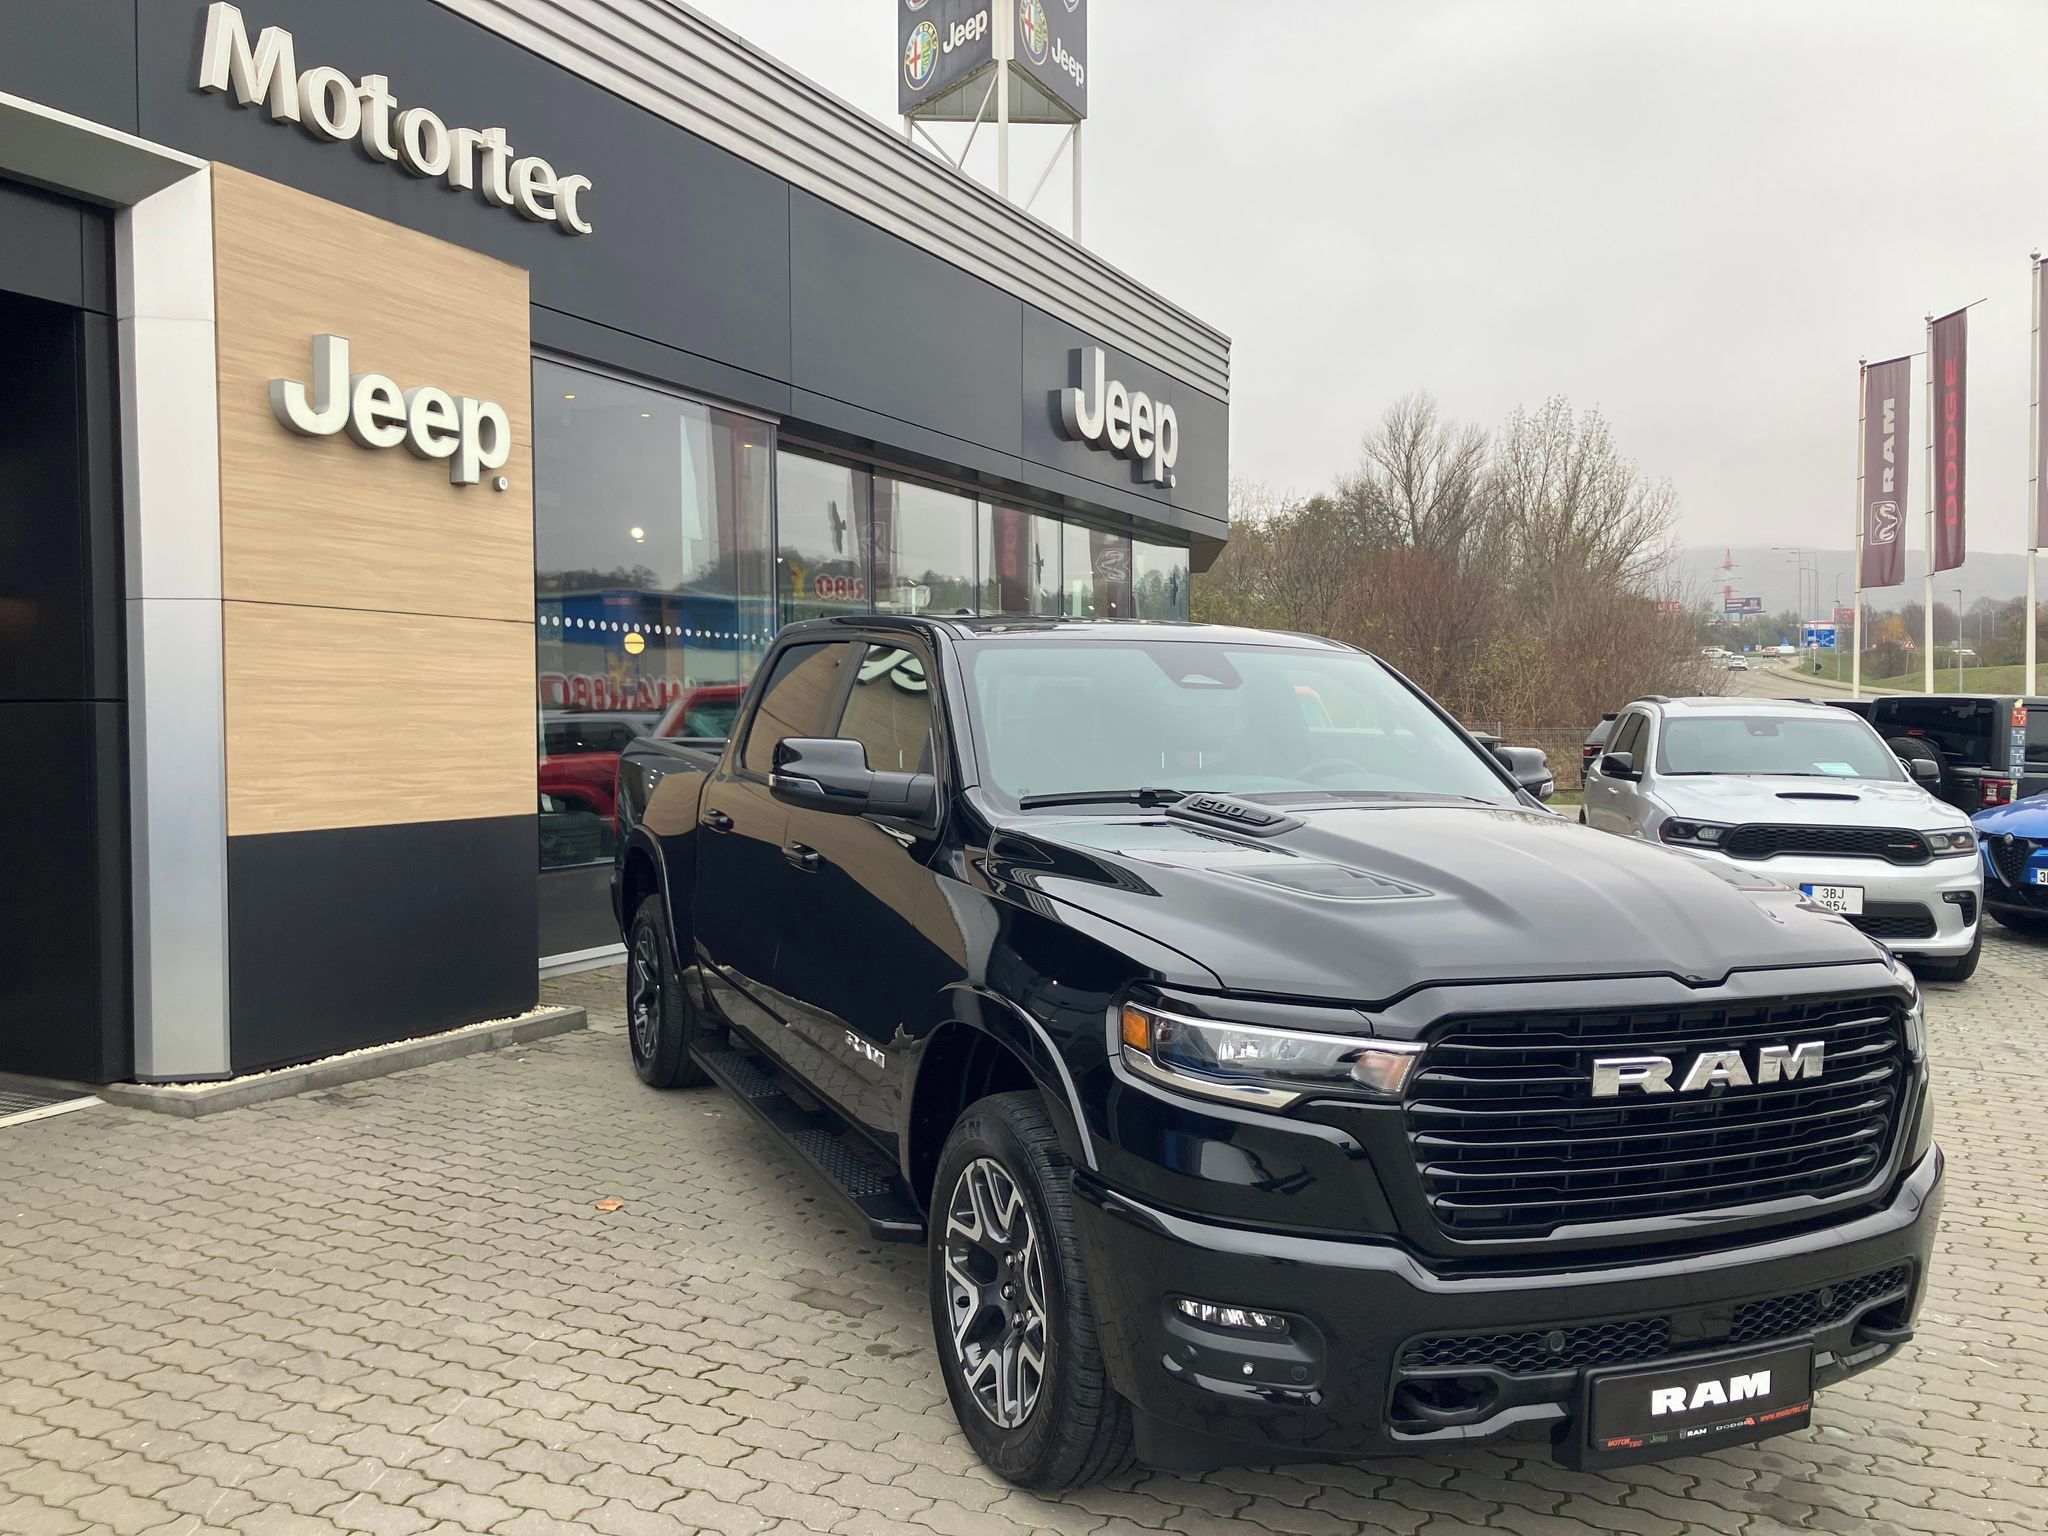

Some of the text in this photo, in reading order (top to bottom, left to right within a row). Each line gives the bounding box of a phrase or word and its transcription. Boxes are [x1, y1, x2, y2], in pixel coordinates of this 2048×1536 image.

[943, 9, 988, 54] Jeep
[1051, 37, 1085, 87] Jeep
[199, 1, 592, 236] Motortec
[269, 333, 511, 486] Jeep
[1060, 346, 1179, 482] Jeep
[1882, 397, 1896, 494] RAM
[1945, 355, 1958, 527] DODGE
[1820, 900, 1847, 912] 954
[1822, 887, 1845, 899] 3BJ
[1592, 1041, 1826, 1097] RAM
[1651, 1370, 1771, 1416] RAM
[1650, 1435, 1668, 1443] Jeep
[1687, 1428, 1707, 1437] RAM
